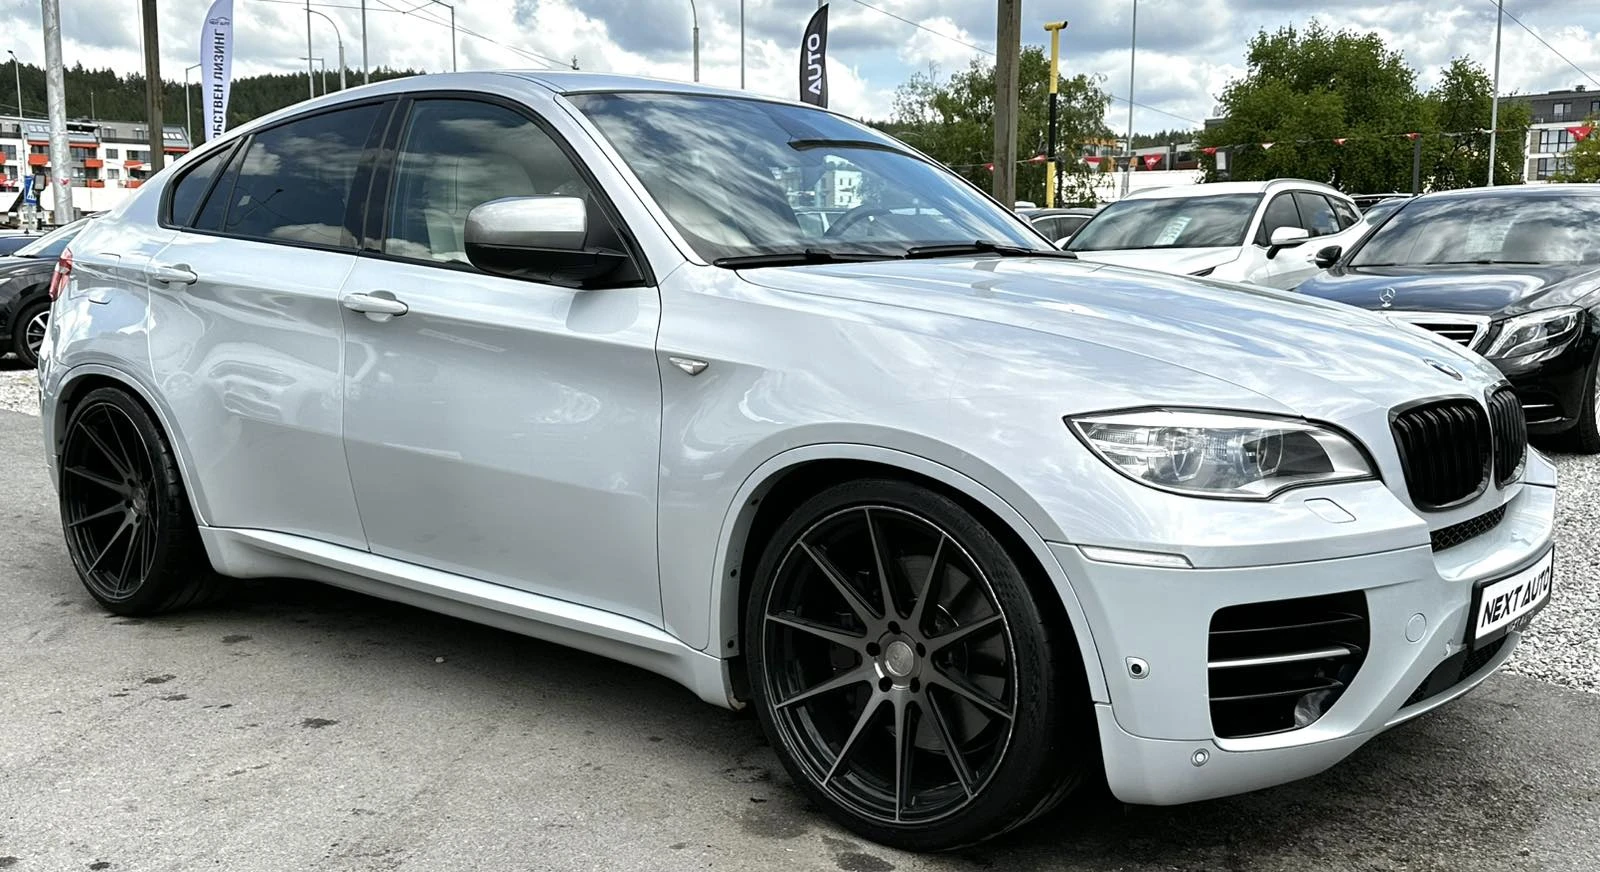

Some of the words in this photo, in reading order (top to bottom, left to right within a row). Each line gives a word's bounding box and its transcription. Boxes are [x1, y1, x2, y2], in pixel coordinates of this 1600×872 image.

[213, 28, 225, 80] ЛИЗИНГ
[807, 33, 822, 95] AUTO
[1481, 584, 1523, 628] NEXT
[1520, 565, 1550, 608] AUTO
